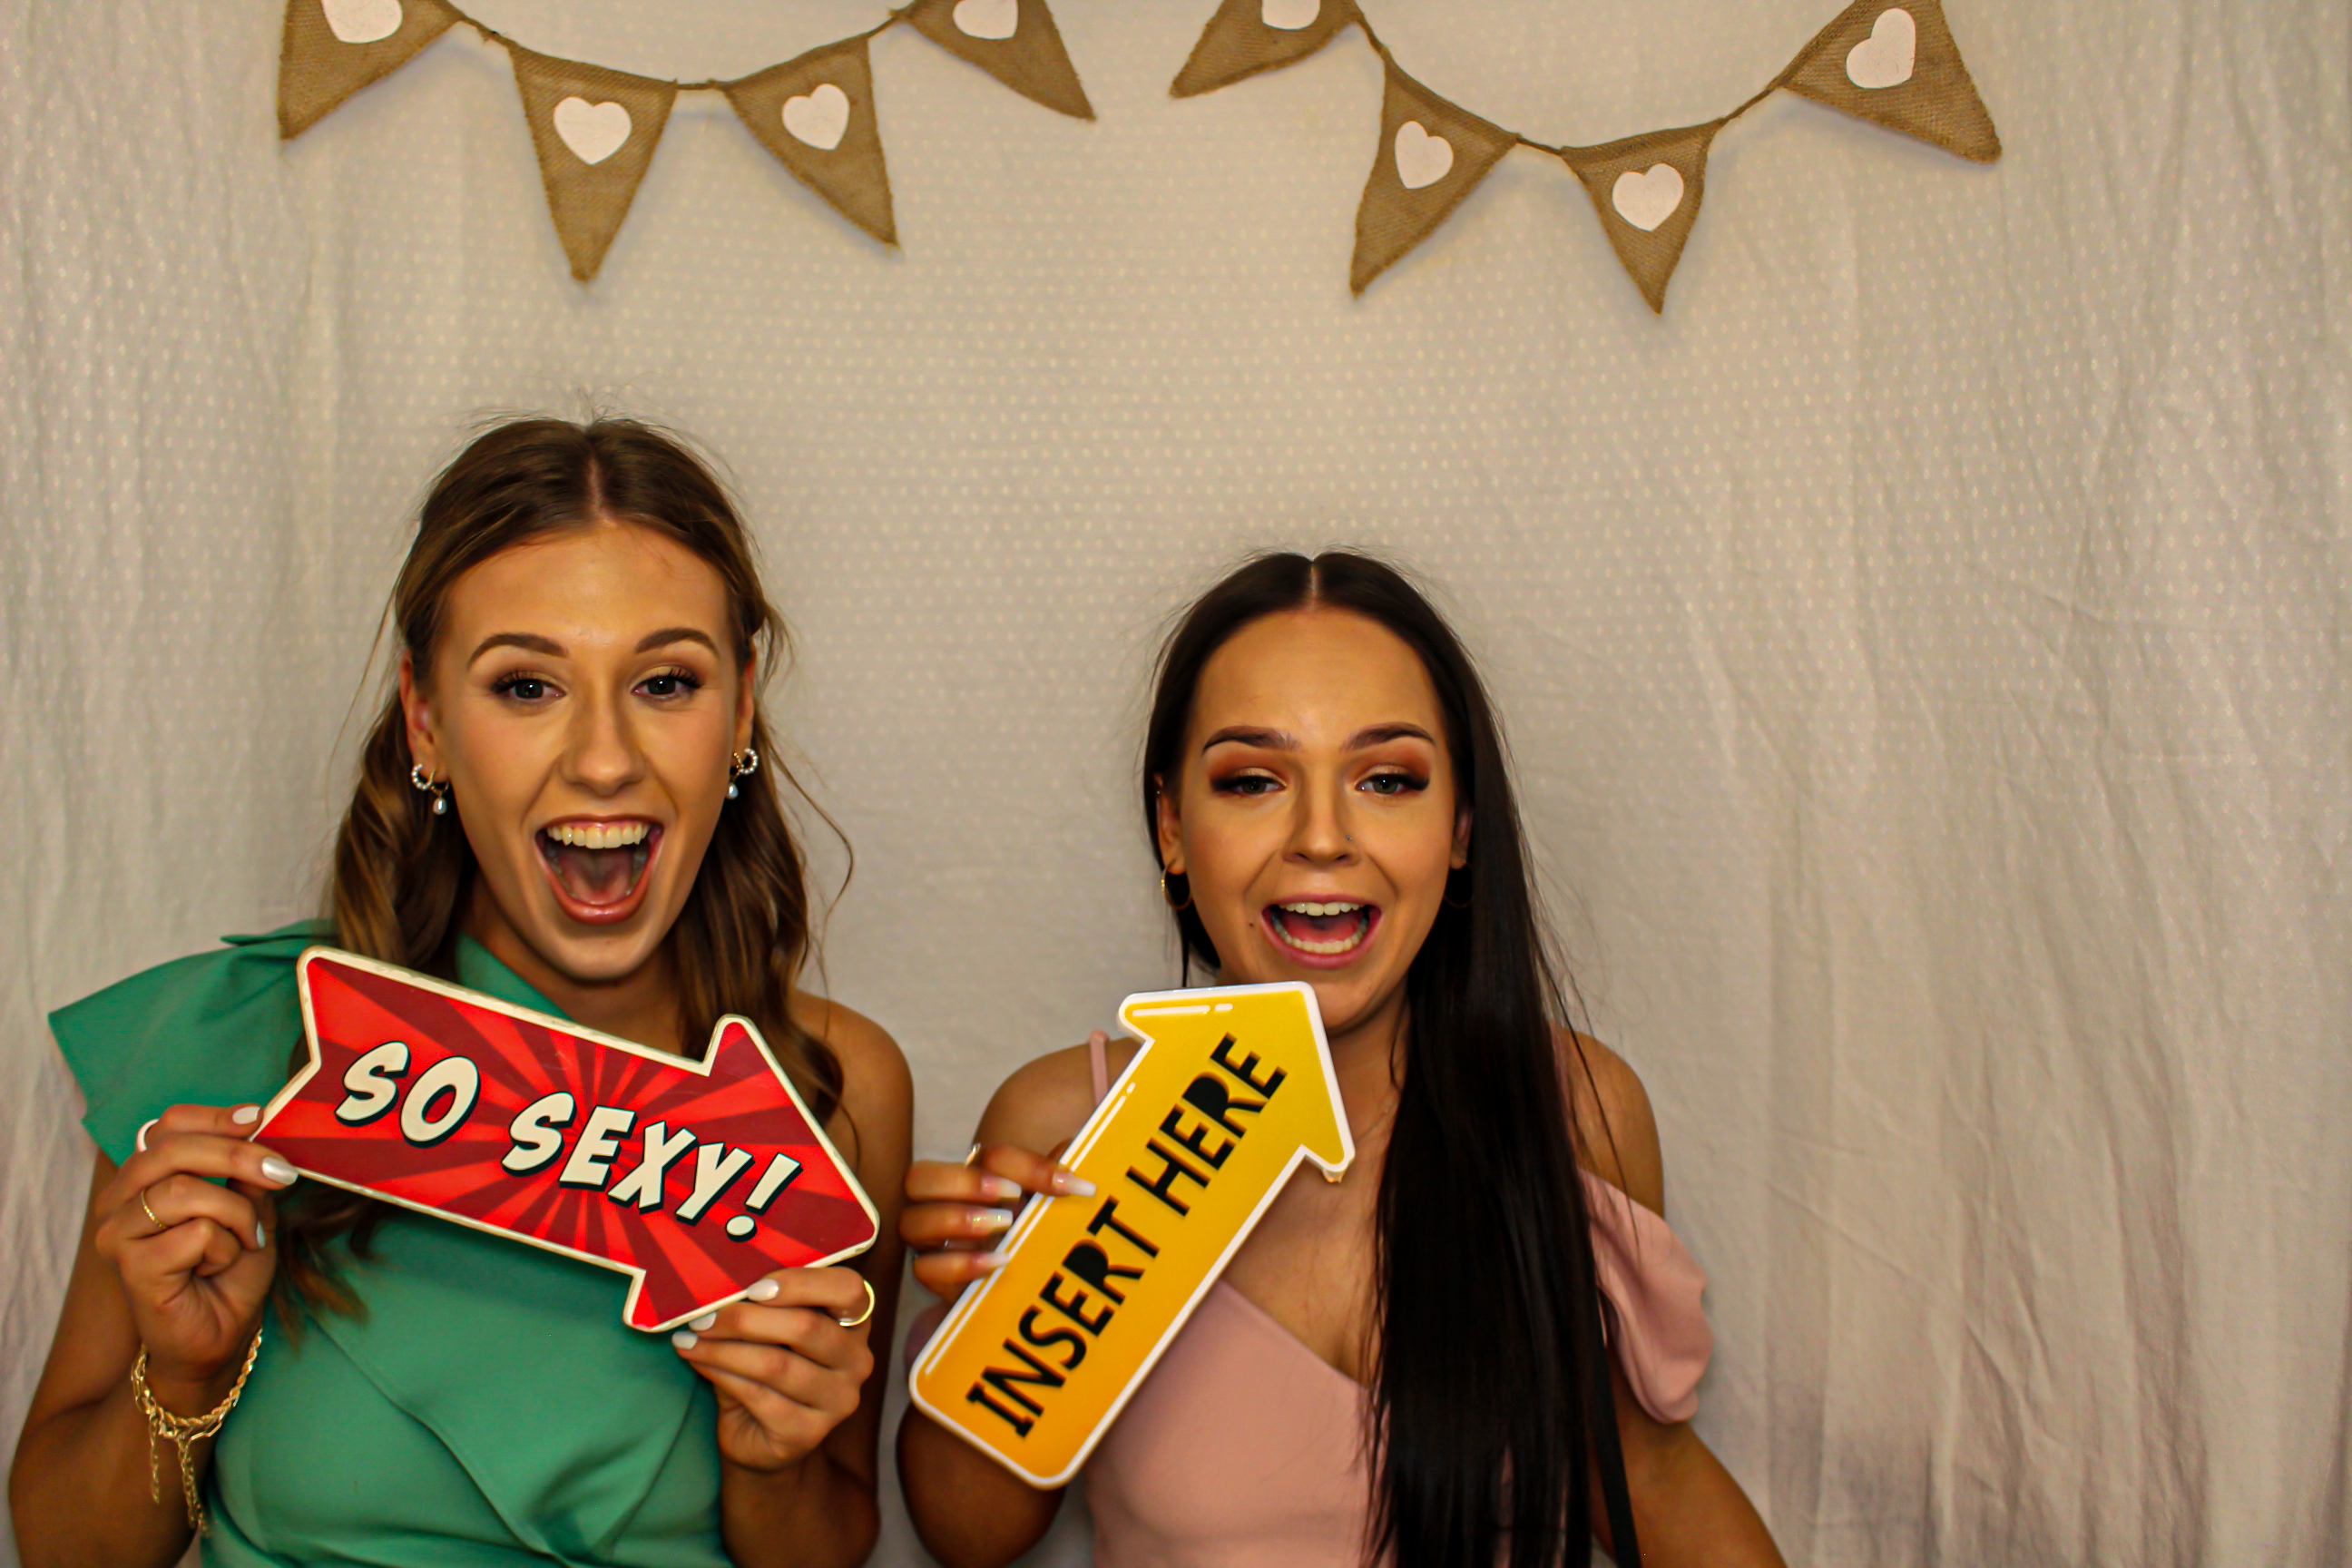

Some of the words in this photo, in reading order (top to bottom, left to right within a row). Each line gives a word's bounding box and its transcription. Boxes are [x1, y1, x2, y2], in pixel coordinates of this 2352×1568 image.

[335, 1041, 481, 1148] SO
[501, 1093, 802, 1241] SEXY!
[965, 1195, 1161, 1438] INSERT
[1125, 1032, 1288, 1217] HERE
